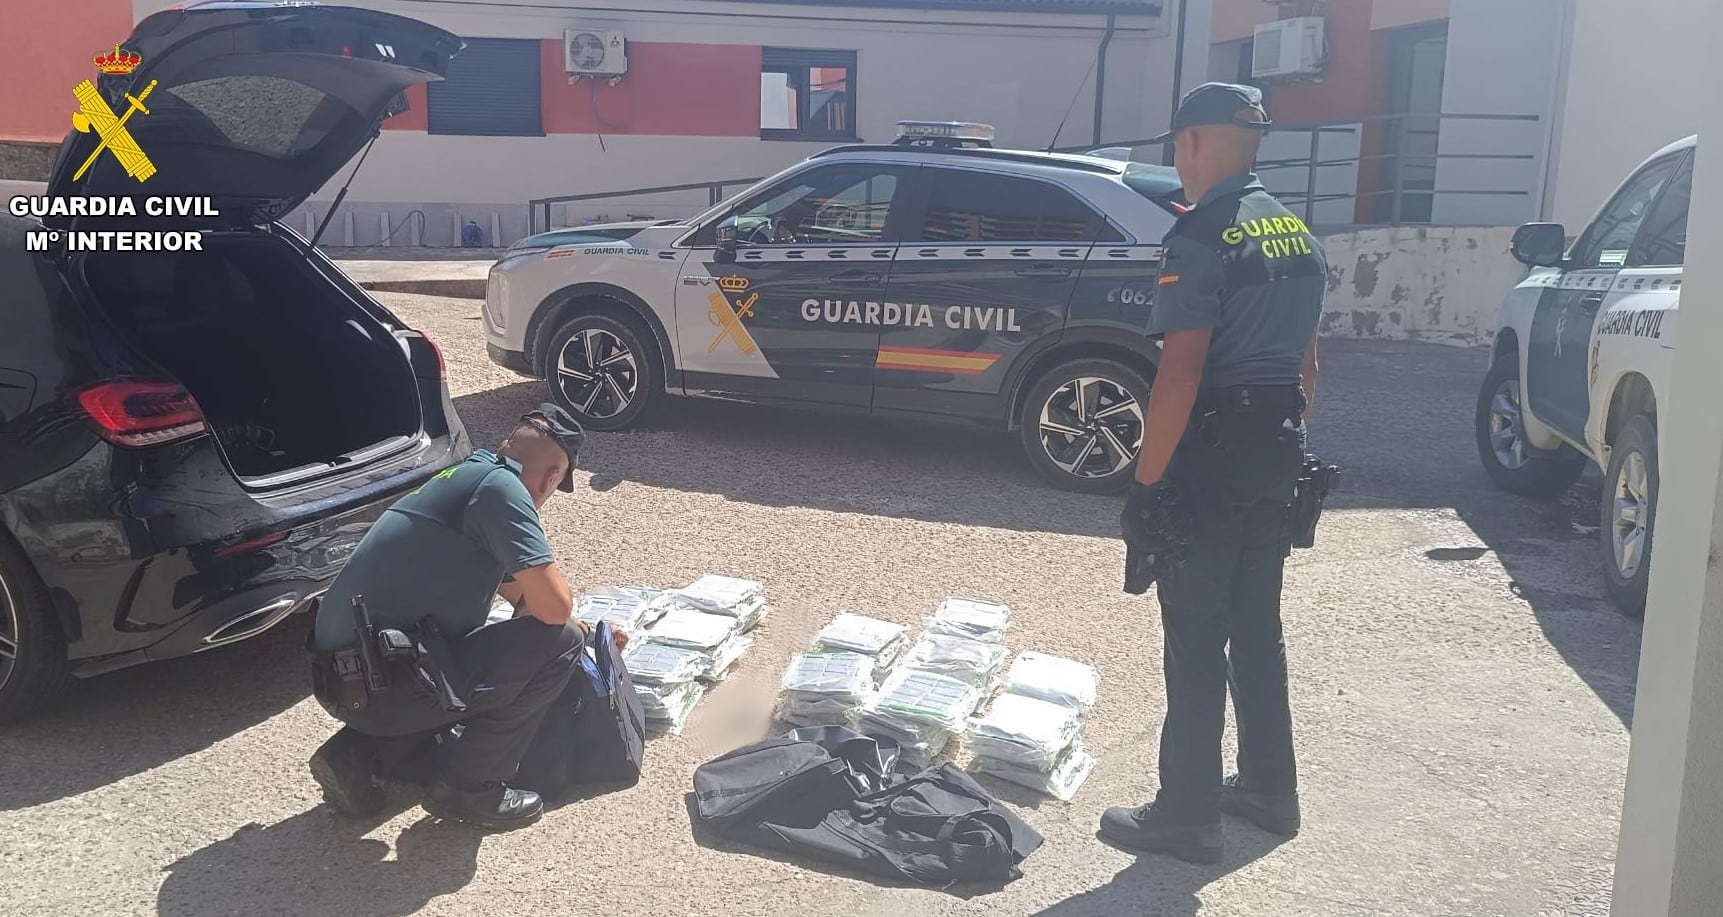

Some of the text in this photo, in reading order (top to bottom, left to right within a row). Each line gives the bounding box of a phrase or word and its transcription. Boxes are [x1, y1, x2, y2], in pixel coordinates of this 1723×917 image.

[627, 248, 650, 256] CIVIL
[1261, 236, 1312, 259] CIVIL
[800, 299, 1021, 332] GUARDIA CIVIL
[1634, 309, 1665, 339] CIVIL
